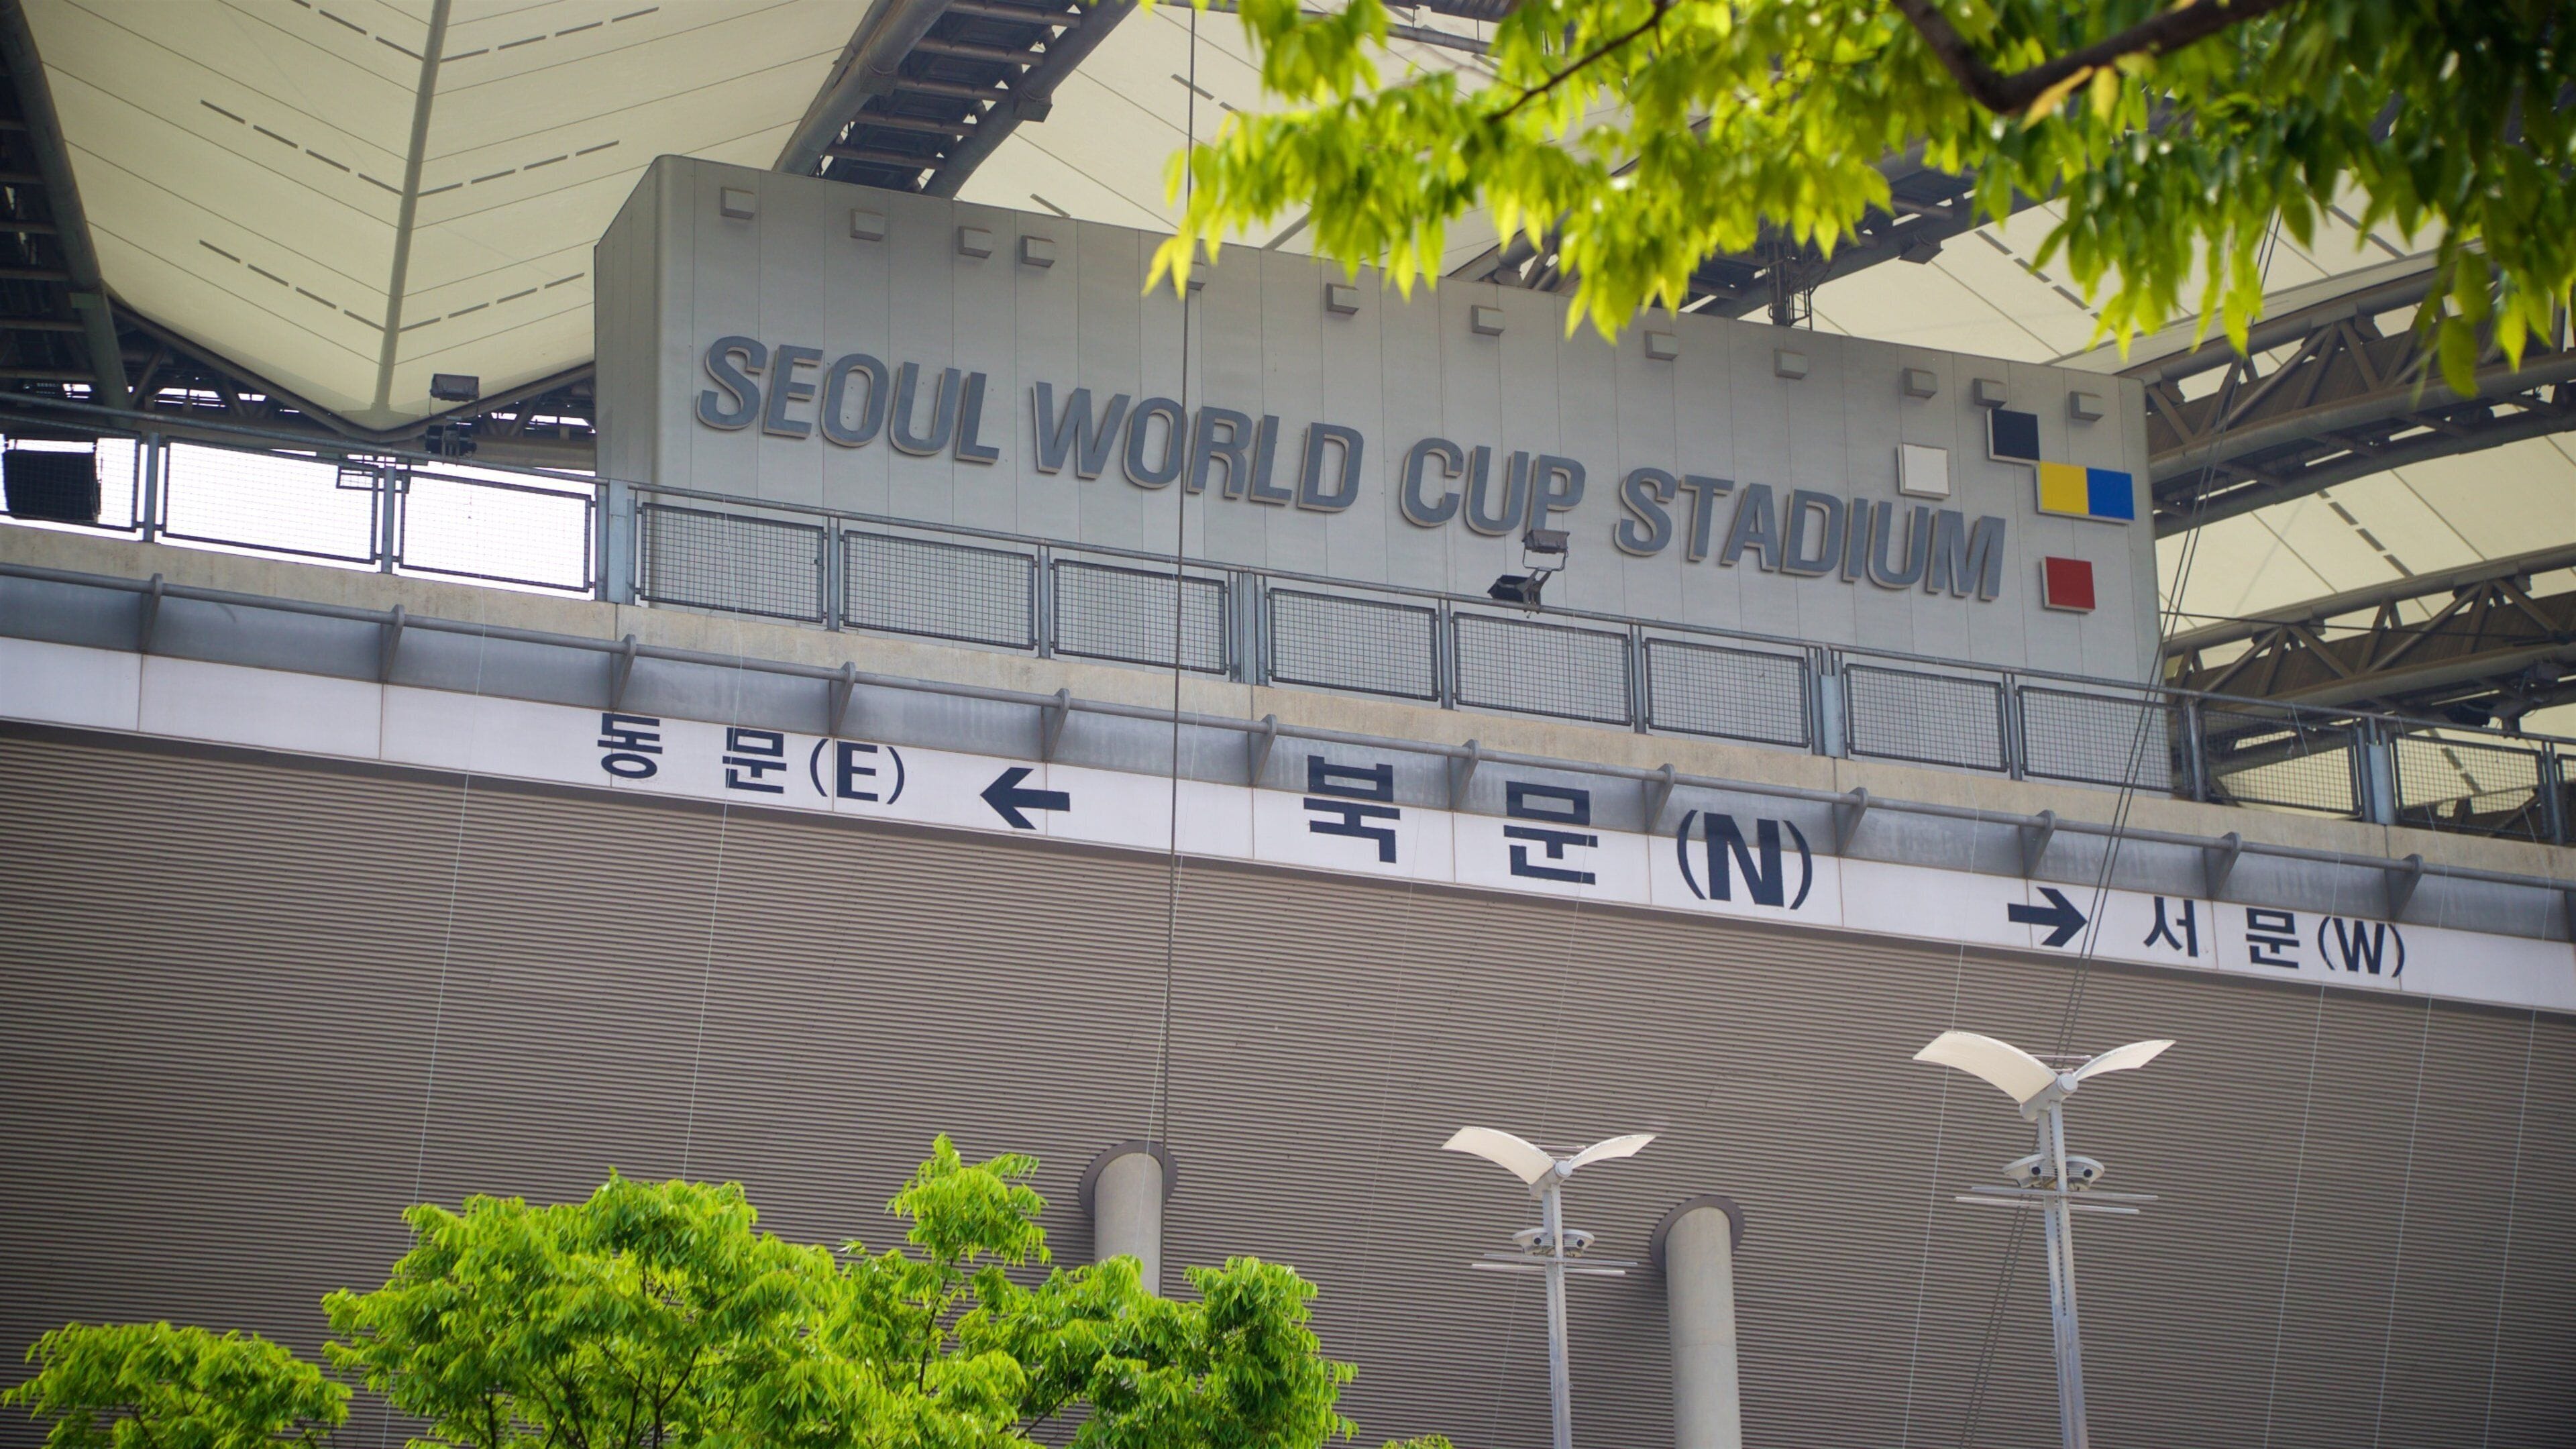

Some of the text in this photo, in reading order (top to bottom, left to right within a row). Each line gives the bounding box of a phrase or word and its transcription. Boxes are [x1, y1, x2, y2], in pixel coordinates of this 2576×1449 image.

[695, 335, 2006, 602] SEOUL WORLD CUP STADIUM
